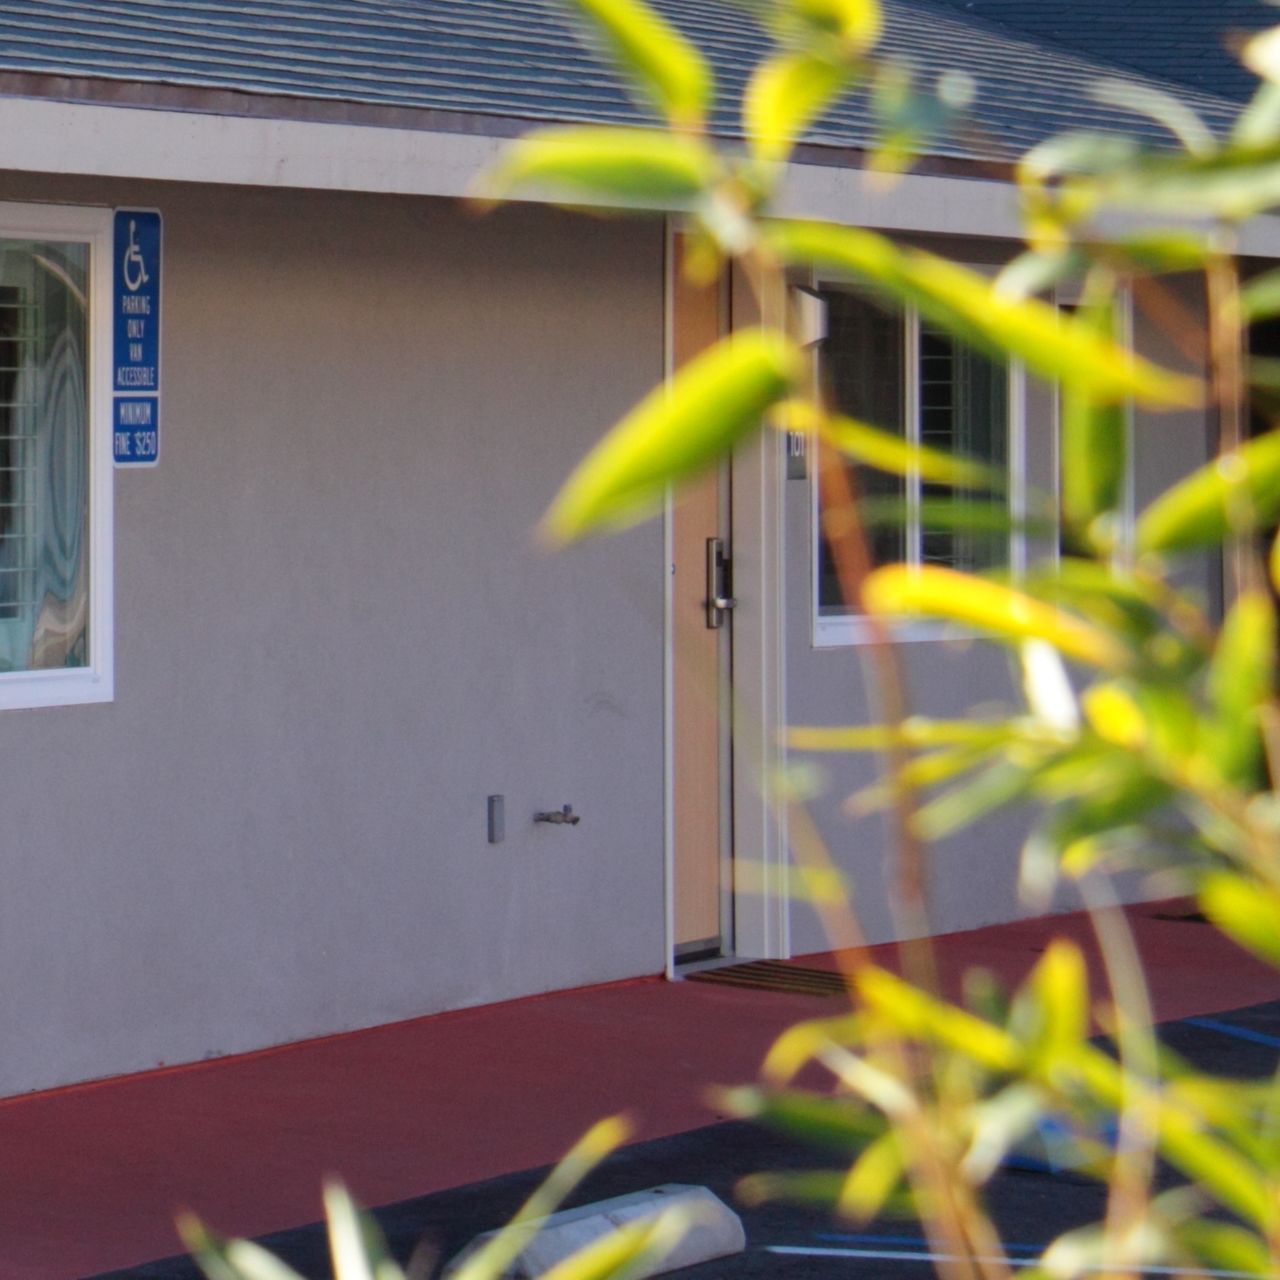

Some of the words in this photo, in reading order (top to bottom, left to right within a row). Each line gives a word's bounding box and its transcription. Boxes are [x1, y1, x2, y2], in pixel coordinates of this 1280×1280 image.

[122, 295, 151, 315] PARKING
[127, 319, 145, 338] ONLY
[129, 343, 143, 362] VAN
[117, 367, 155, 386] ACCESSIBLE
[120, 402, 151, 425] MINIMUM
[115, 431, 131, 455] FINE
[134, 431, 156, 456] $250
[789, 431, 805, 457] 101
